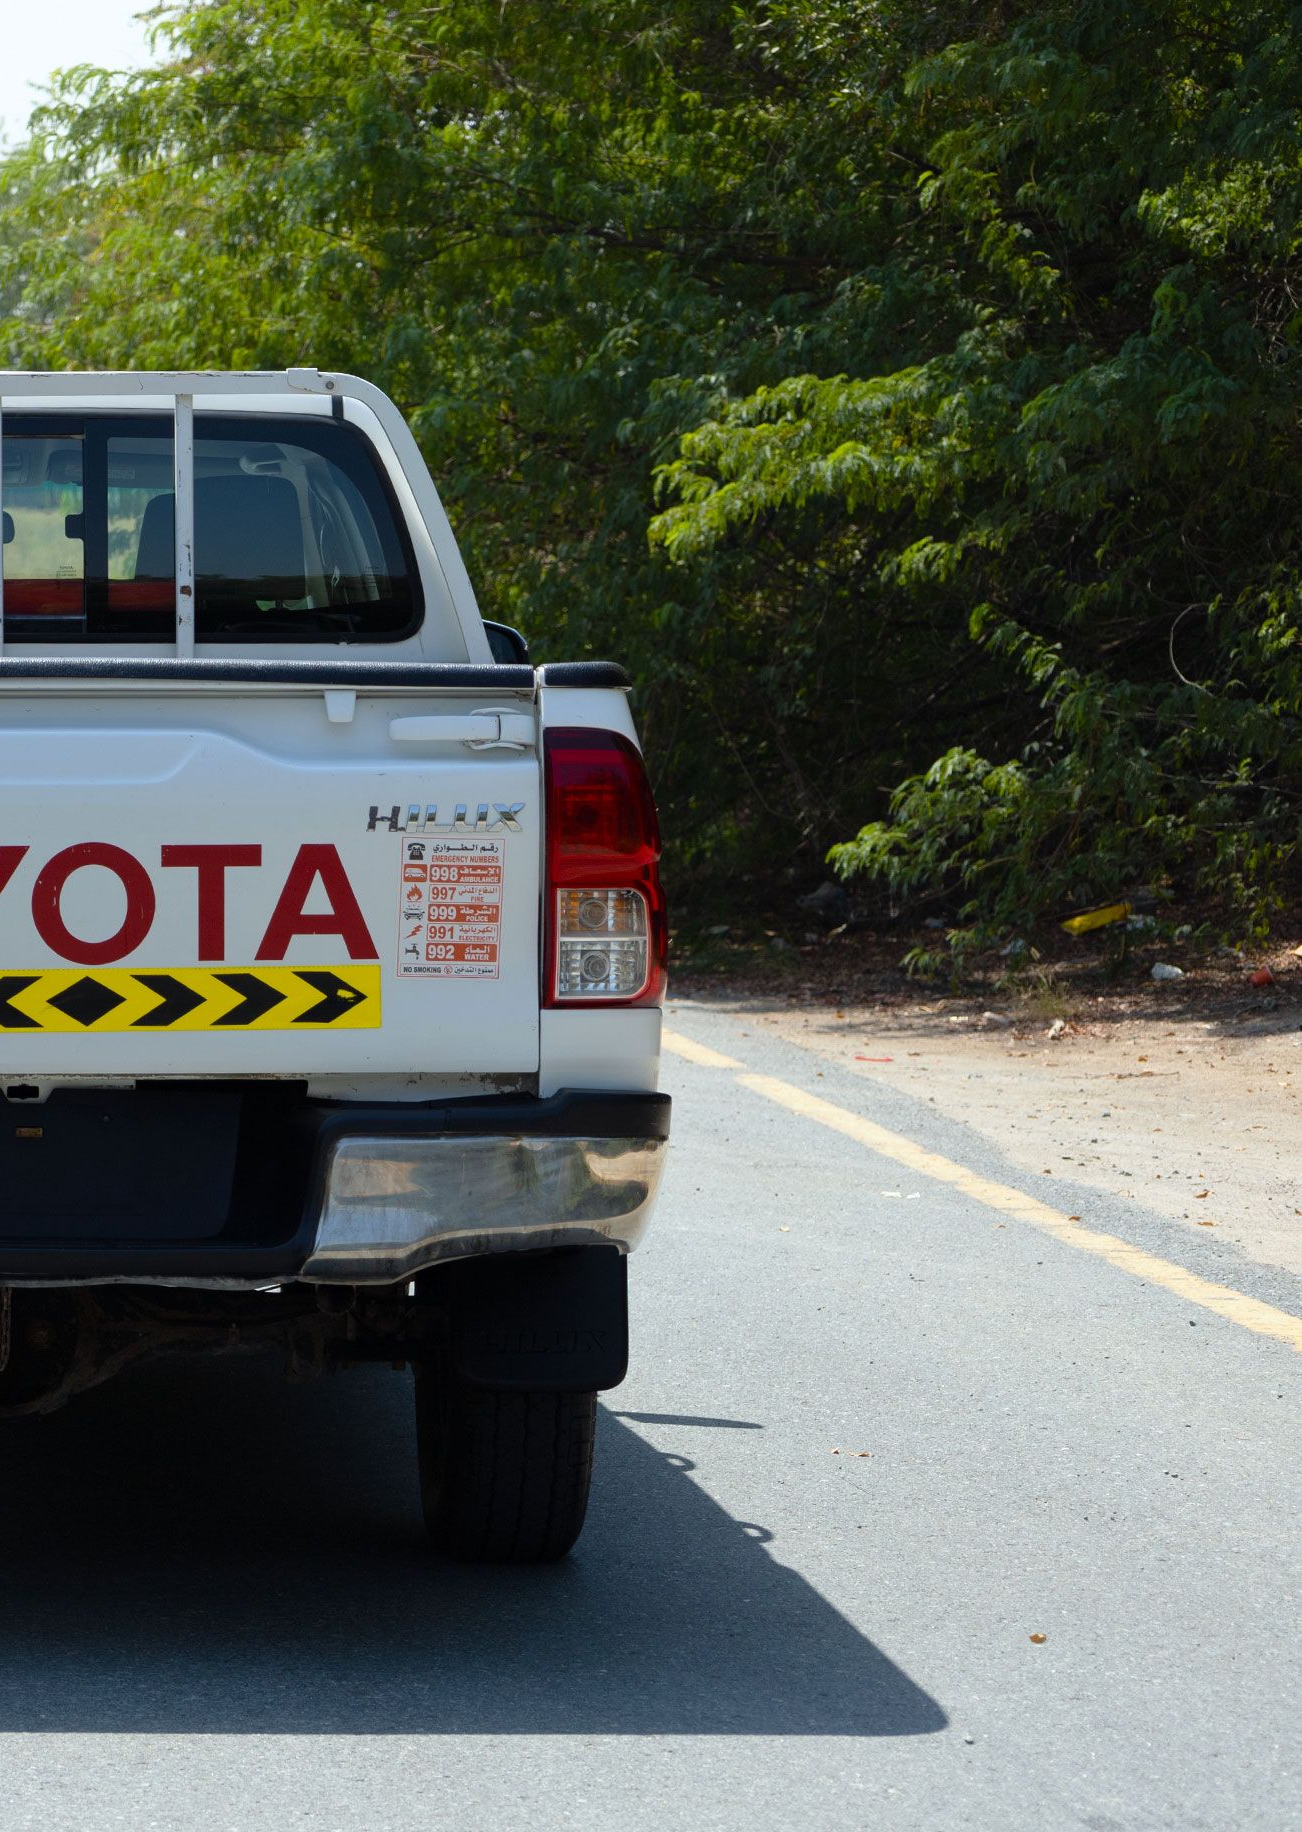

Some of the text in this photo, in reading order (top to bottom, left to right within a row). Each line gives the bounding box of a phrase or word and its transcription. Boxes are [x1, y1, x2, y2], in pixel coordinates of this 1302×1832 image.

[366, 802, 526, 833] HILUX
[480, 843, 499, 853] رقم
[431, 855, 499, 864] EMERGENCY NUMBERS
[431, 866, 458, 881] 998
[431, 886, 457, 900] 997
[429, 906, 457, 920] 999
[459, 905, 496, 916] الشرطة
[429, 925, 455, 939] 991
[427, 945, 455, 960] 992
[413, 966, 441, 974] SMOKING
